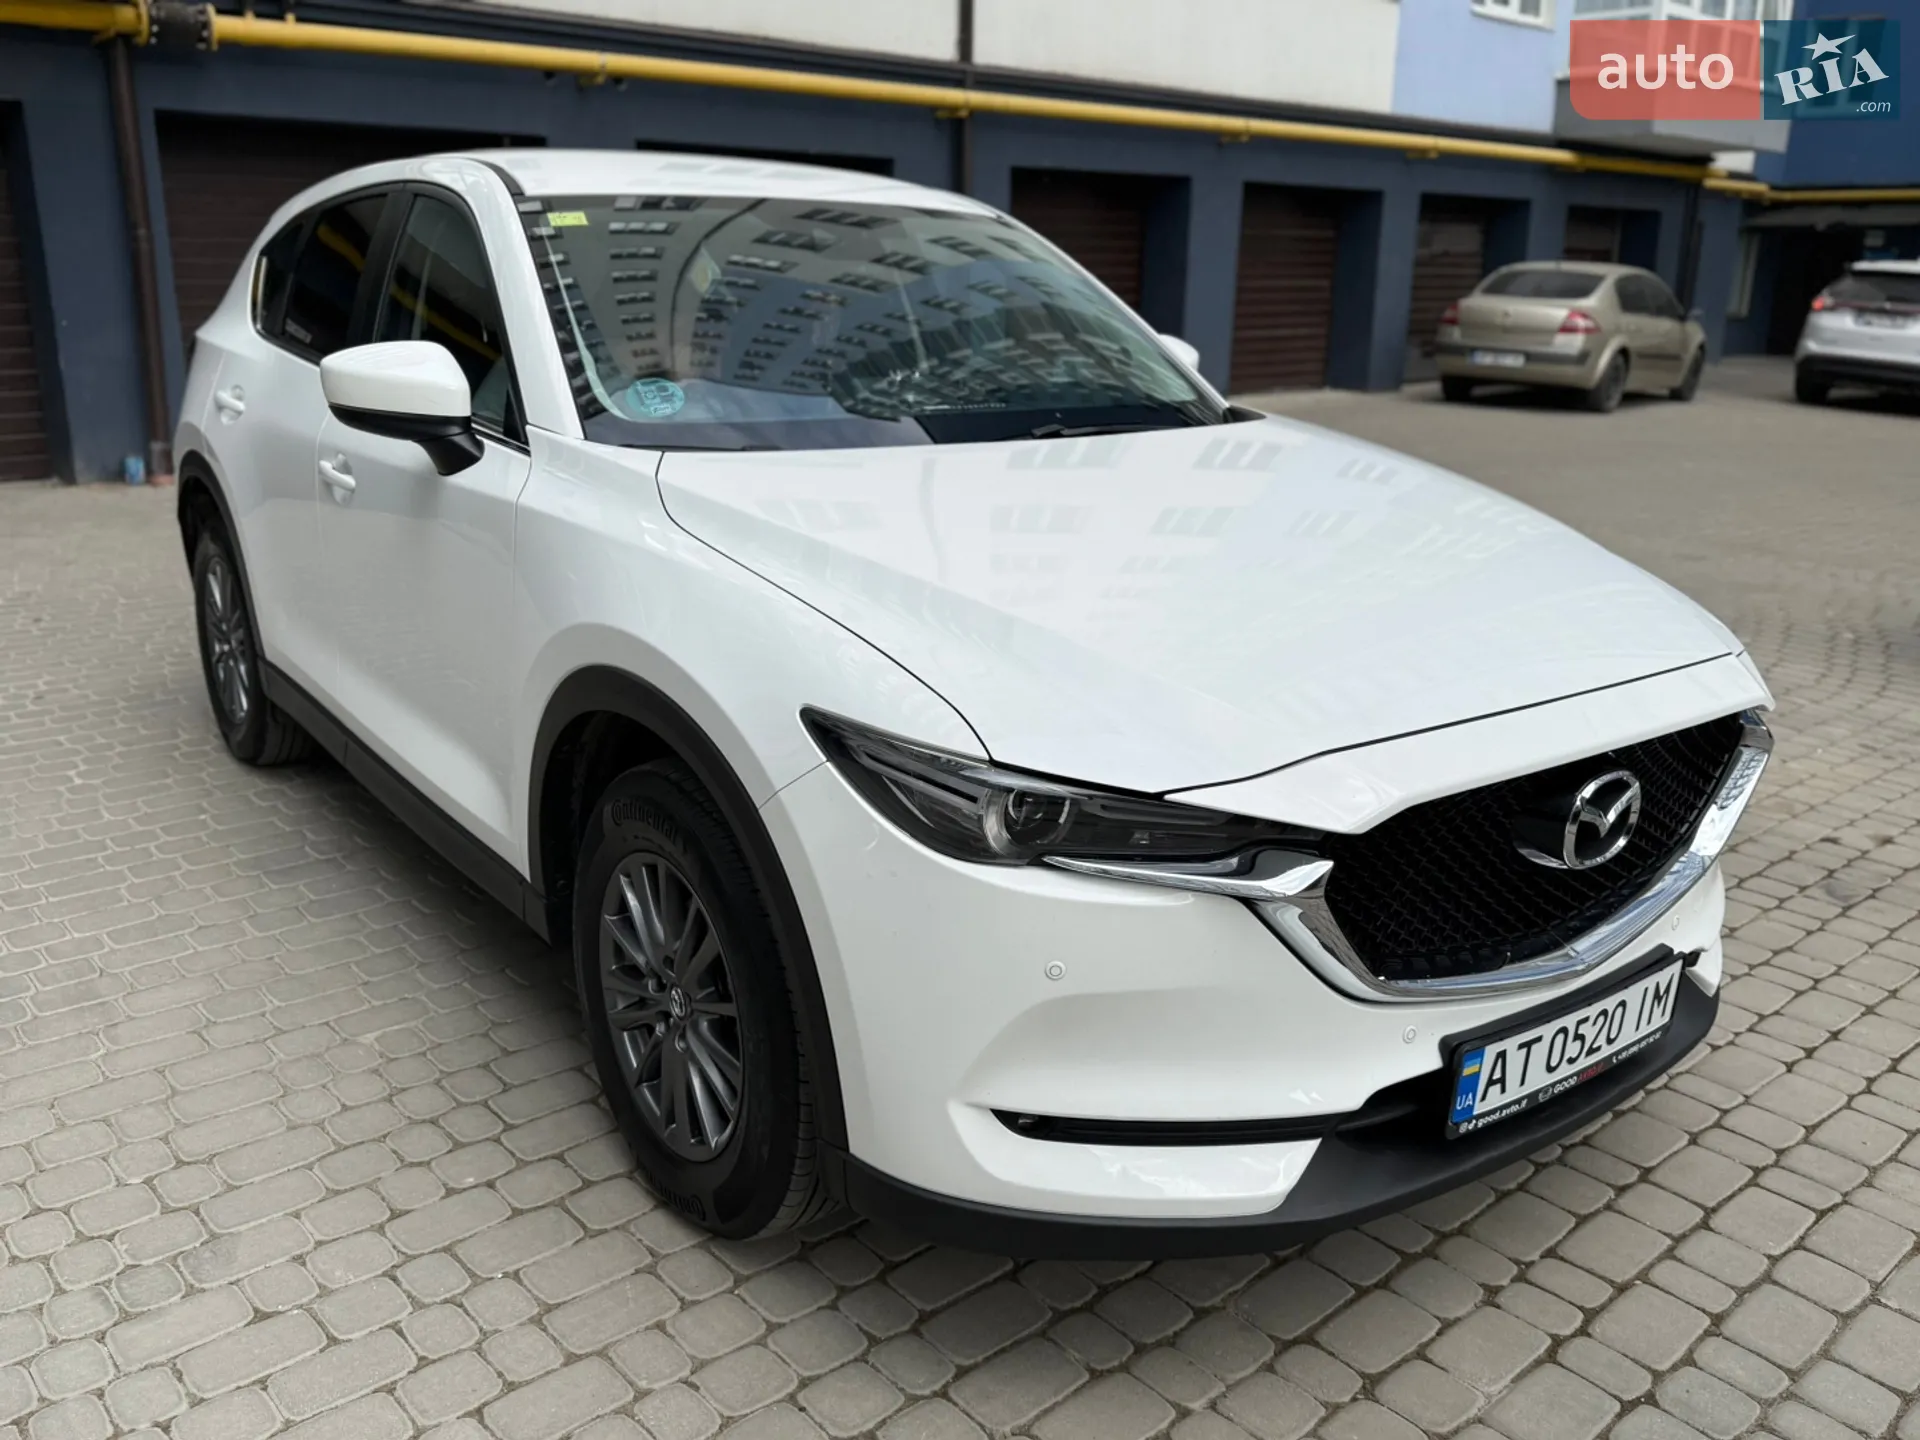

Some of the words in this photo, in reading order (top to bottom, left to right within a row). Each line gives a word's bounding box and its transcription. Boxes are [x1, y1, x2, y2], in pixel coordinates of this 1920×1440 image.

[611, 799, 677, 847] Continental
[1479, 1035, 1544, 1102] AT
[1546, 999, 1627, 1074] 0520
[1635, 972, 1674, 1032] IM
[1456, 1092, 1473, 1110] UA
